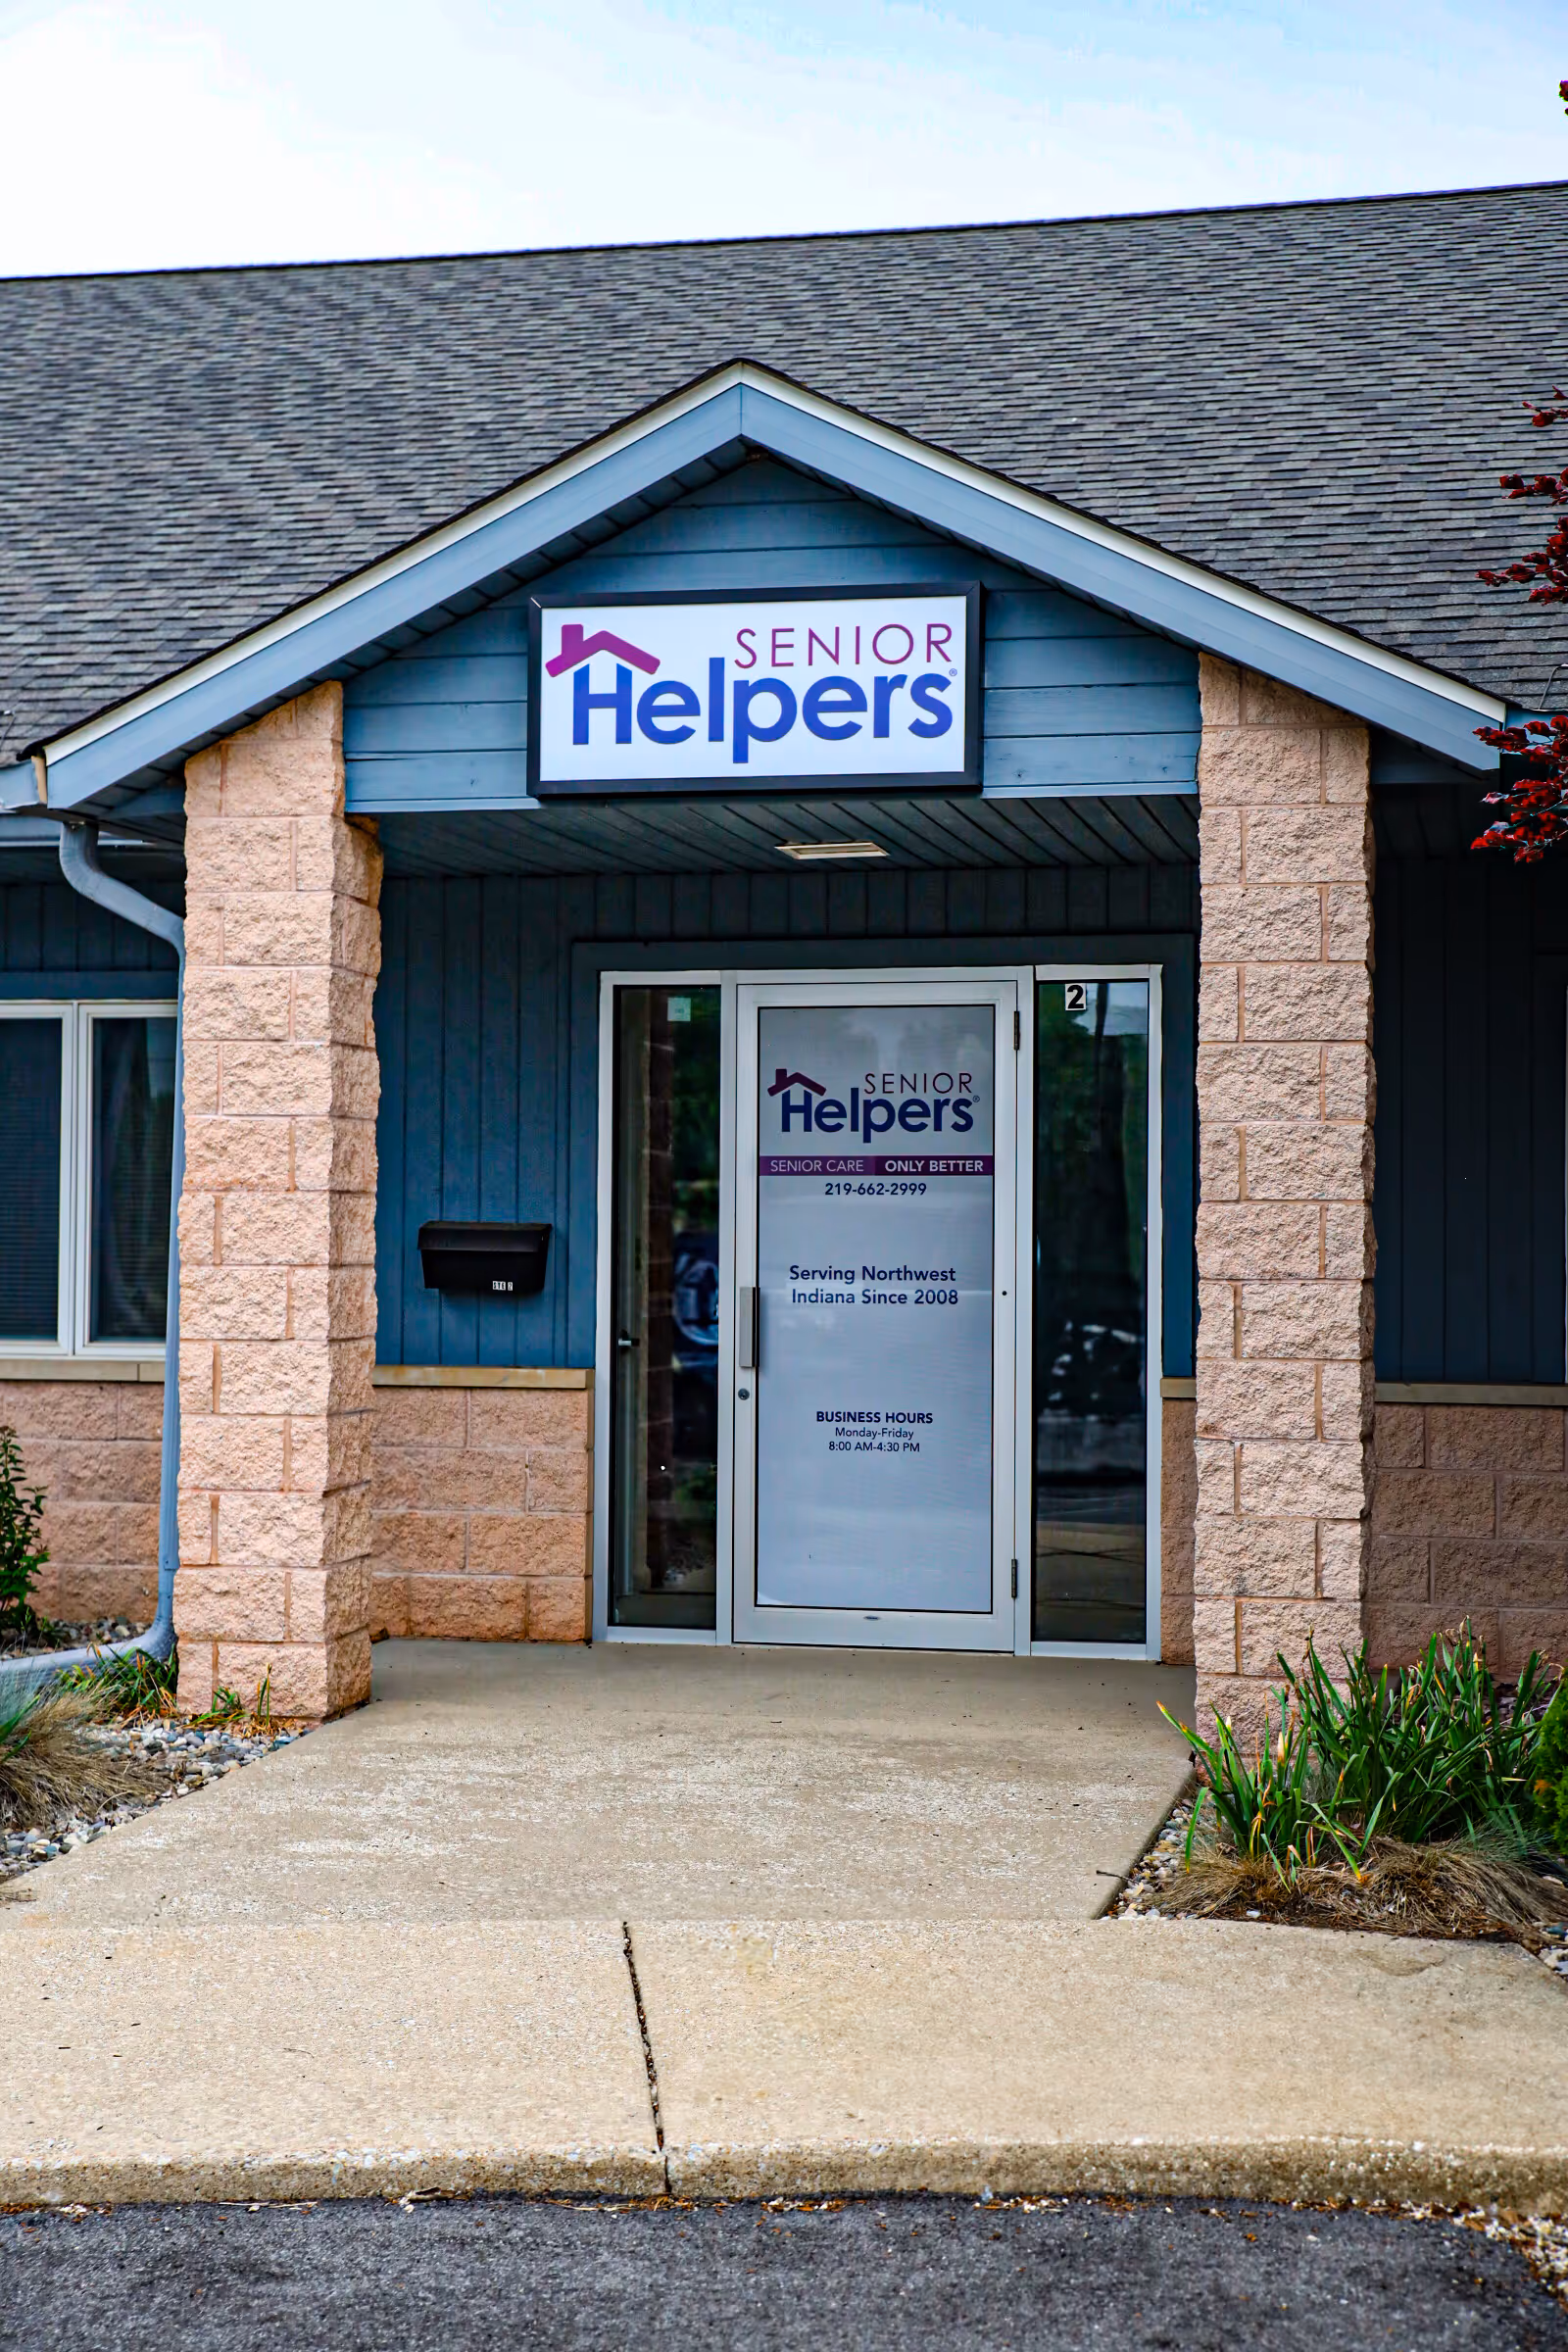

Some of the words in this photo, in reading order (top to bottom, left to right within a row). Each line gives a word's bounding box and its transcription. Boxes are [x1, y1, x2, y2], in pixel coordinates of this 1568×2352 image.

[734, 623, 953, 669] SENIOR
[1066, 984, 1085, 1009] 2
[863, 1072, 973, 1095] SENIOR
[770, 1159, 822, 1173] SENIOR
[826, 1159, 864, 1173] CARE
[884, 1159, 924, 1173] ONLY
[929, 1159, 984, 1173] BETTER
[824, 1182, 927, 1196] 219-662-2999
[789, 1264, 856, 1285] Serving
[861, 1264, 956, 1282] Northwest
[792, 1288, 856, 1304] Indiana
[861, 1289, 908, 1305] Since
[913, 1289, 958, 1305] 2008
[815, 1410, 881, 1423] BUSINESS
[885, 1411, 934, 1424] HOURS
[835, 1427, 914, 1441] Monday-Friday
[828, 1441, 852, 1451] 8:00
[854, 1442, 900, 1452] AM-4:30
[902, 1442, 920, 1452] PM
